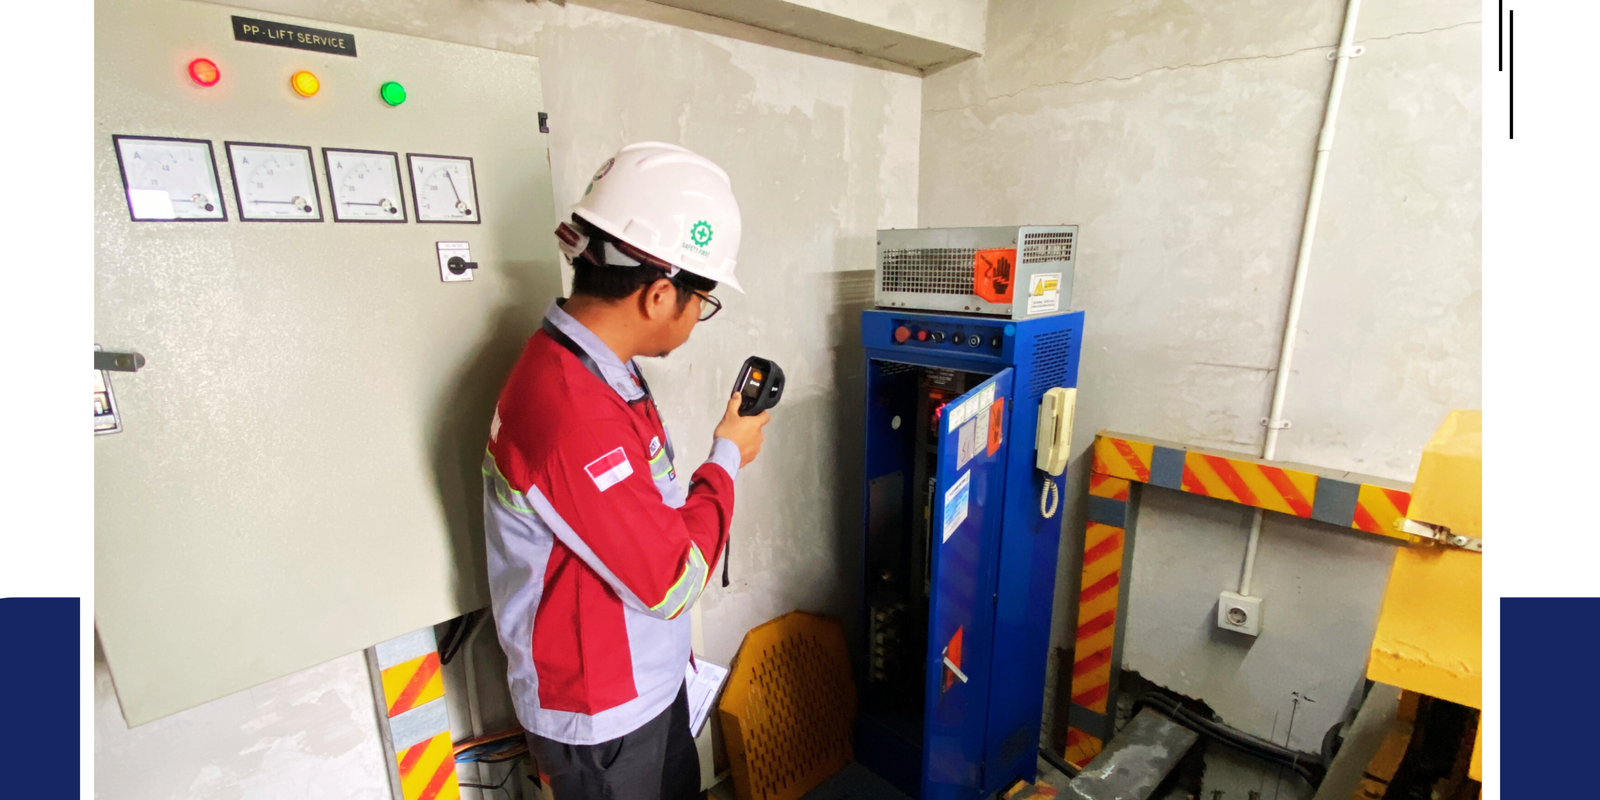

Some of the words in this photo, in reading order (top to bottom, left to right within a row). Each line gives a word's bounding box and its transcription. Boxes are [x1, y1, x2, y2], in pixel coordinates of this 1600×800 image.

[297, 32, 346, 49] SERVICE
[134, 151, 142, 160] A
[242, 156, 250, 165] A
[336, 161, 343, 169] A
[418, 166, 424, 174] V
[681, 241, 698, 254] SAFETY
[698, 249, 711, 257] FIRST
